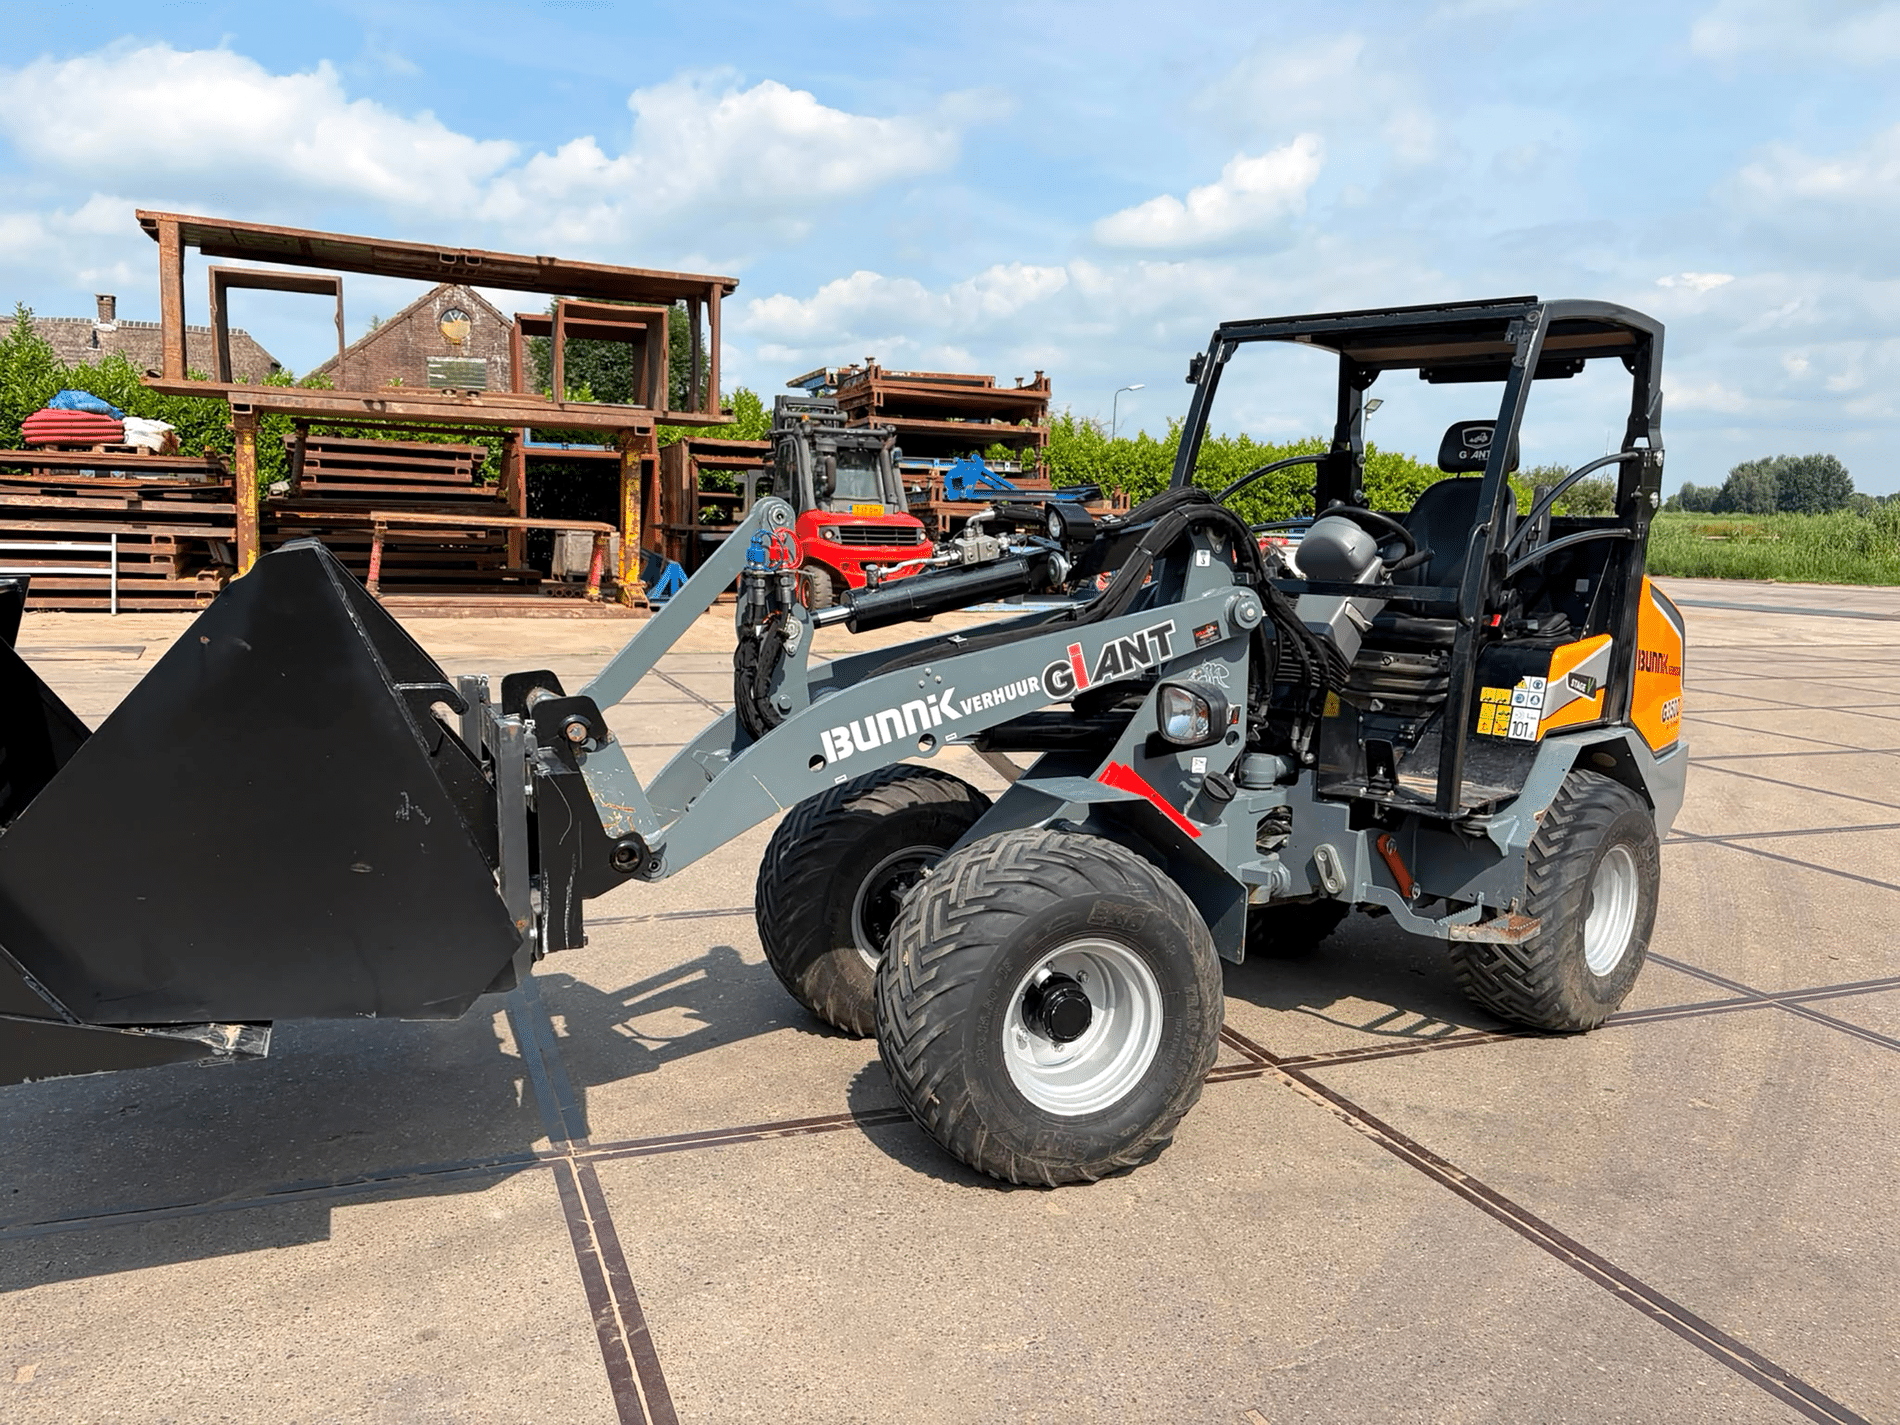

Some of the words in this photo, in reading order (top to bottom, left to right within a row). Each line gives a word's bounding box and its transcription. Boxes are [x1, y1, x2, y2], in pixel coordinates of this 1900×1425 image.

[1570, 678, 1587, 693] STAGE
[960, 677, 1040, 716] VERHUUR
[1512, 721, 1529, 738] 101
